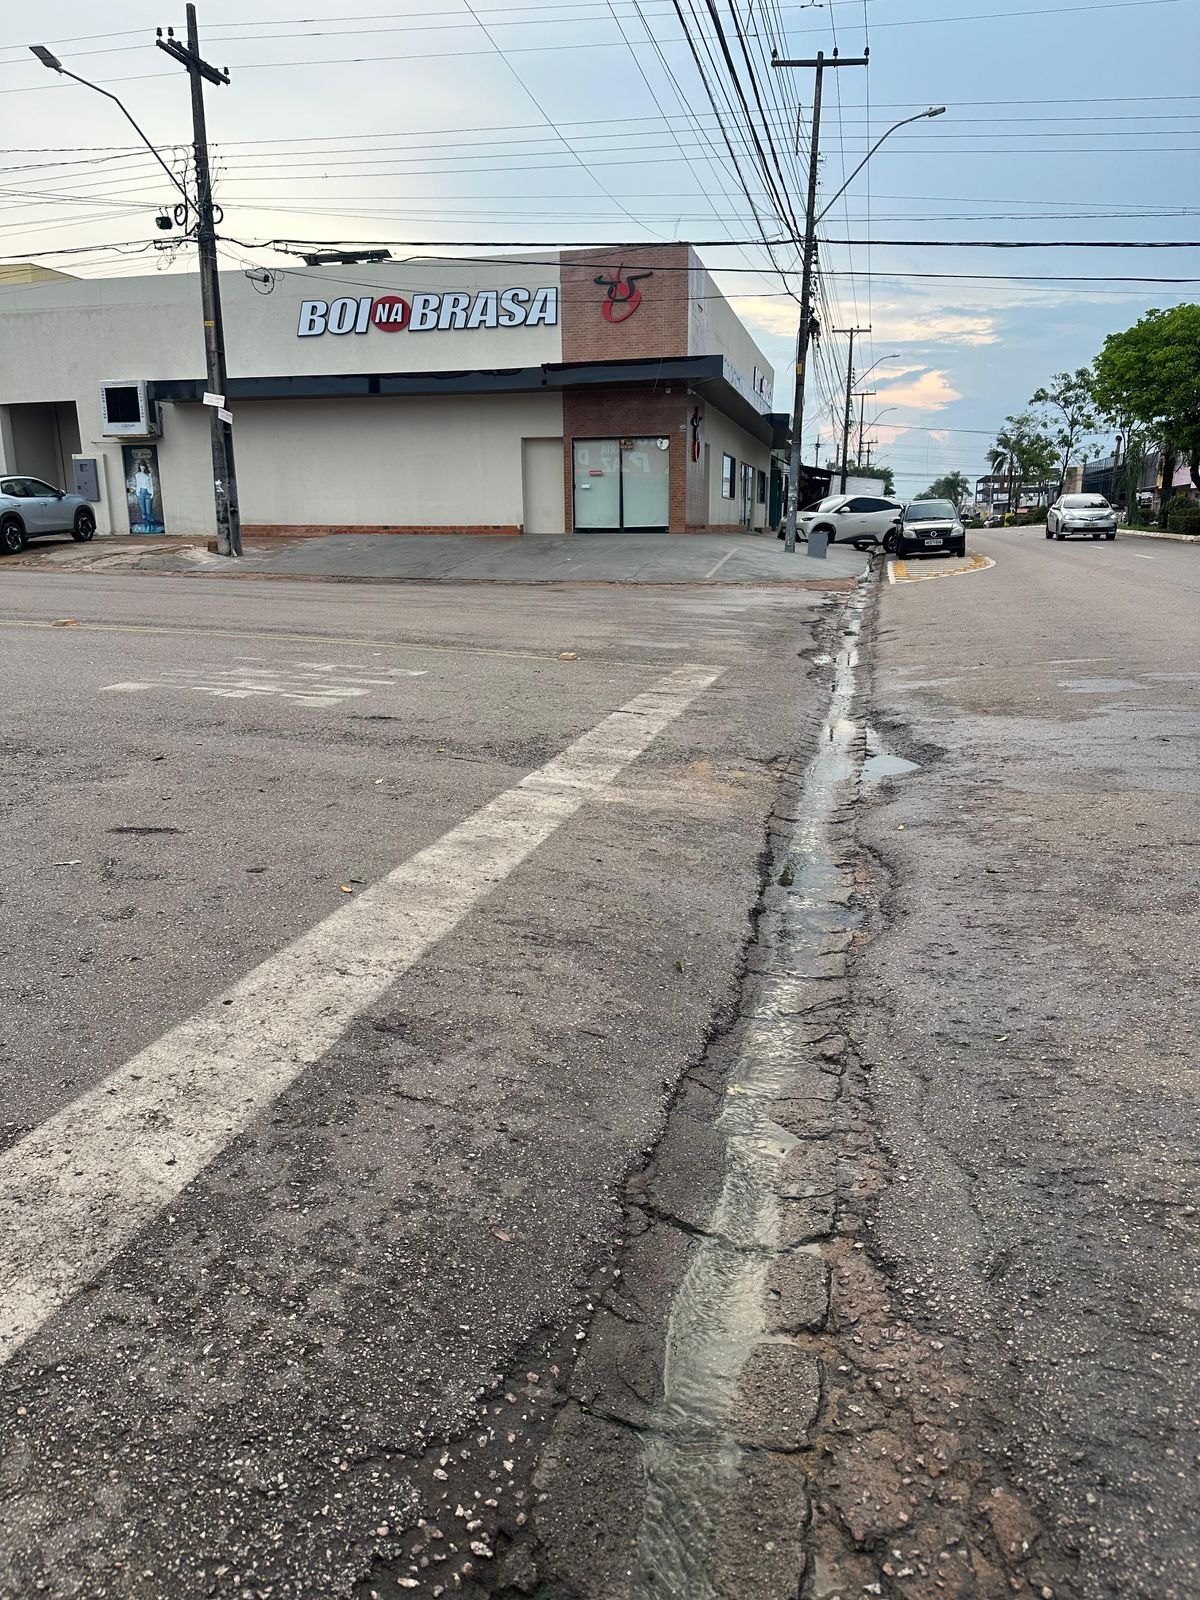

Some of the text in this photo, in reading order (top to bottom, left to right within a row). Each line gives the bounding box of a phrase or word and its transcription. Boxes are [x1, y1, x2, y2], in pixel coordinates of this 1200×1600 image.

[297, 286, 559, 337] BOI NA BRASA
